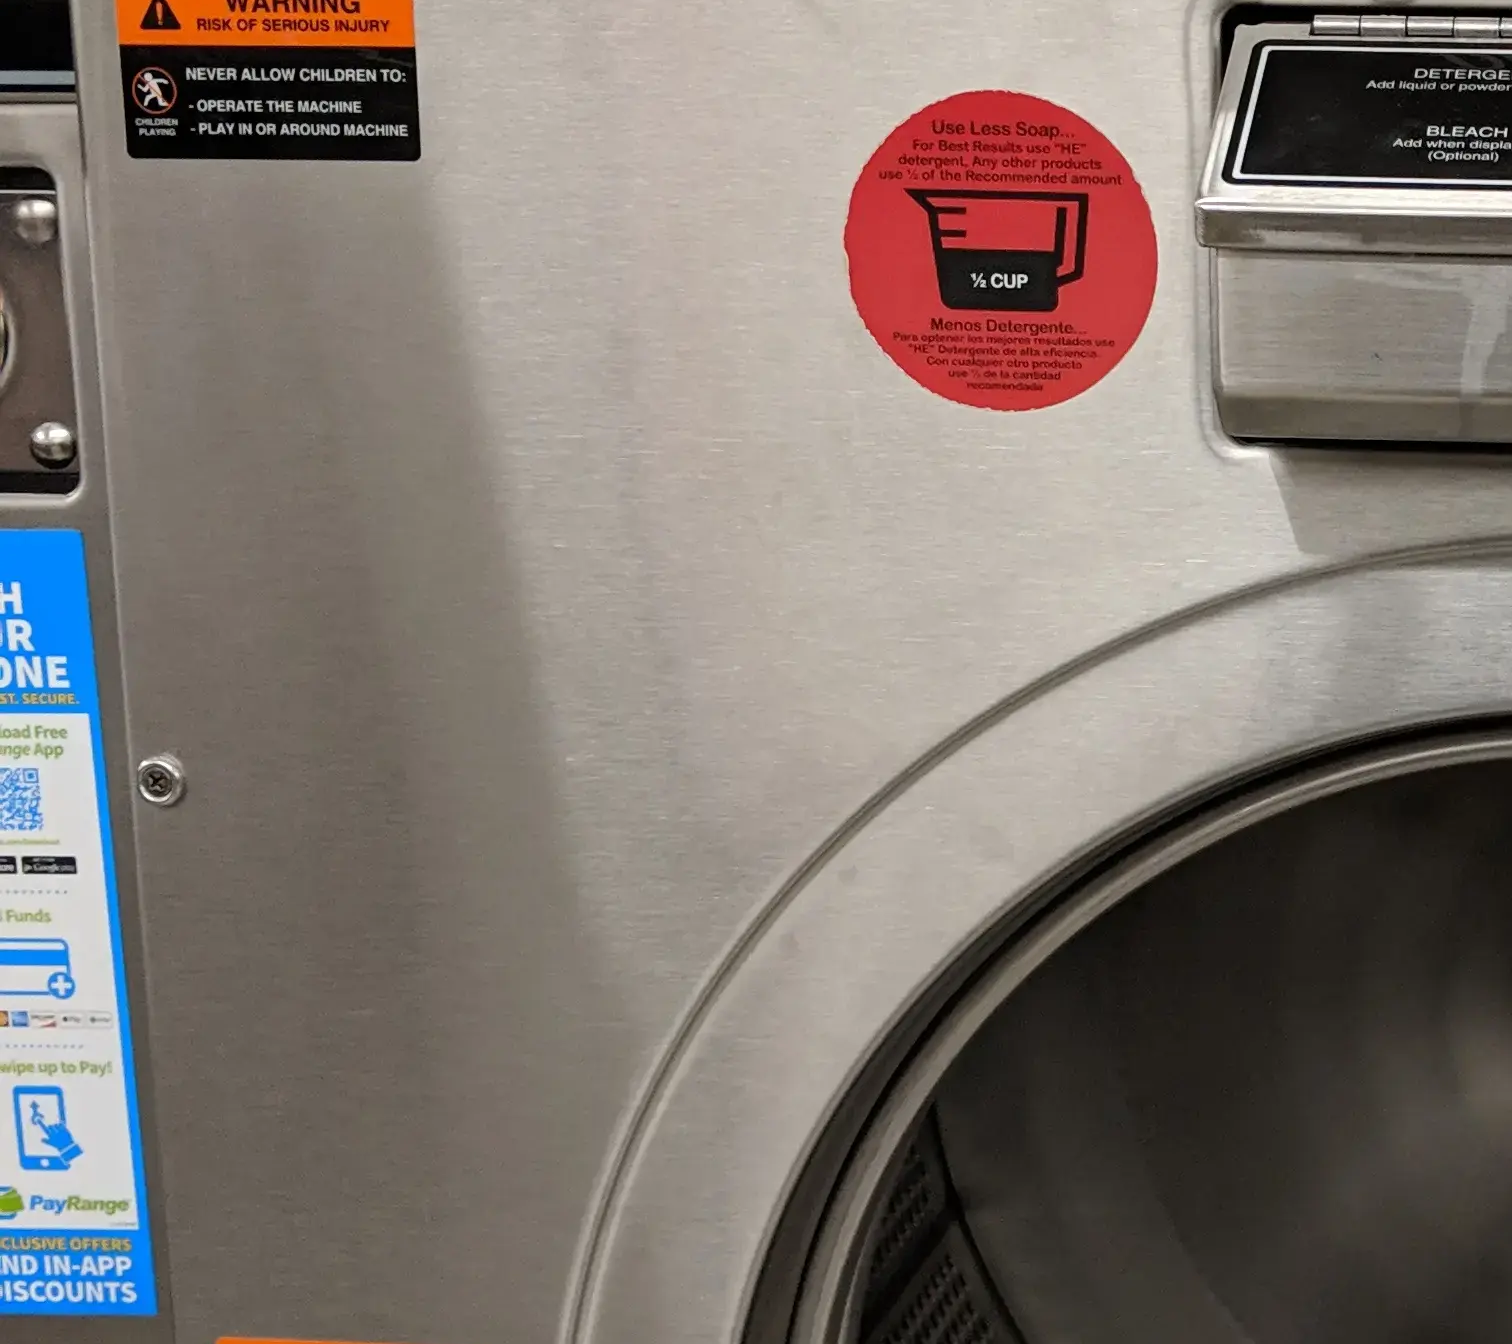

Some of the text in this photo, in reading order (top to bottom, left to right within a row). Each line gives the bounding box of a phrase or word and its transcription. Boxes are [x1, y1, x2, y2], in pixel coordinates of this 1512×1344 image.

[197, 19, 389, 32] RISK OF SERIOUS INJURY
[186, 68, 406, 82] NEVER ALLOW CHILDREN TO:
[1366, 80, 1395, 89] Add
[1400, 81, 1436, 92] liquid
[1458, 83, 1512, 92] powder
[197, 100, 362, 113] OPERATE THE MACHINE
[199, 124, 408, 137] PLAY IN OR AROUND MACHINE
[932, 120, 965, 134] Use
[970, 121, 1010, 135] Less
[1426, 126, 1508, 137] BLEACH
[912, 140, 934, 150] For
[939, 140, 969, 151] Best
[973, 141, 1022, 153] Results
[1026, 144, 1050, 153] use
[1393, 138, 1422, 147] Add
[1427, 140, 1465, 149] when
[1428, 151, 1499, 162] (Optional)
[991, 273, 1028, 288] CUP
[931, 318, 981, 332] Menos
[22, 693, 79, 704] SECURE.
[34, 726, 67, 739] Free
[34, 744, 63, 758] App
[6, 910, 51, 922] Funds
[29, 1195, 130, 1215] PayRange
[70, 1238, 131, 1250] OFFERS
[43, 1256, 132, 1276] IN-APP
